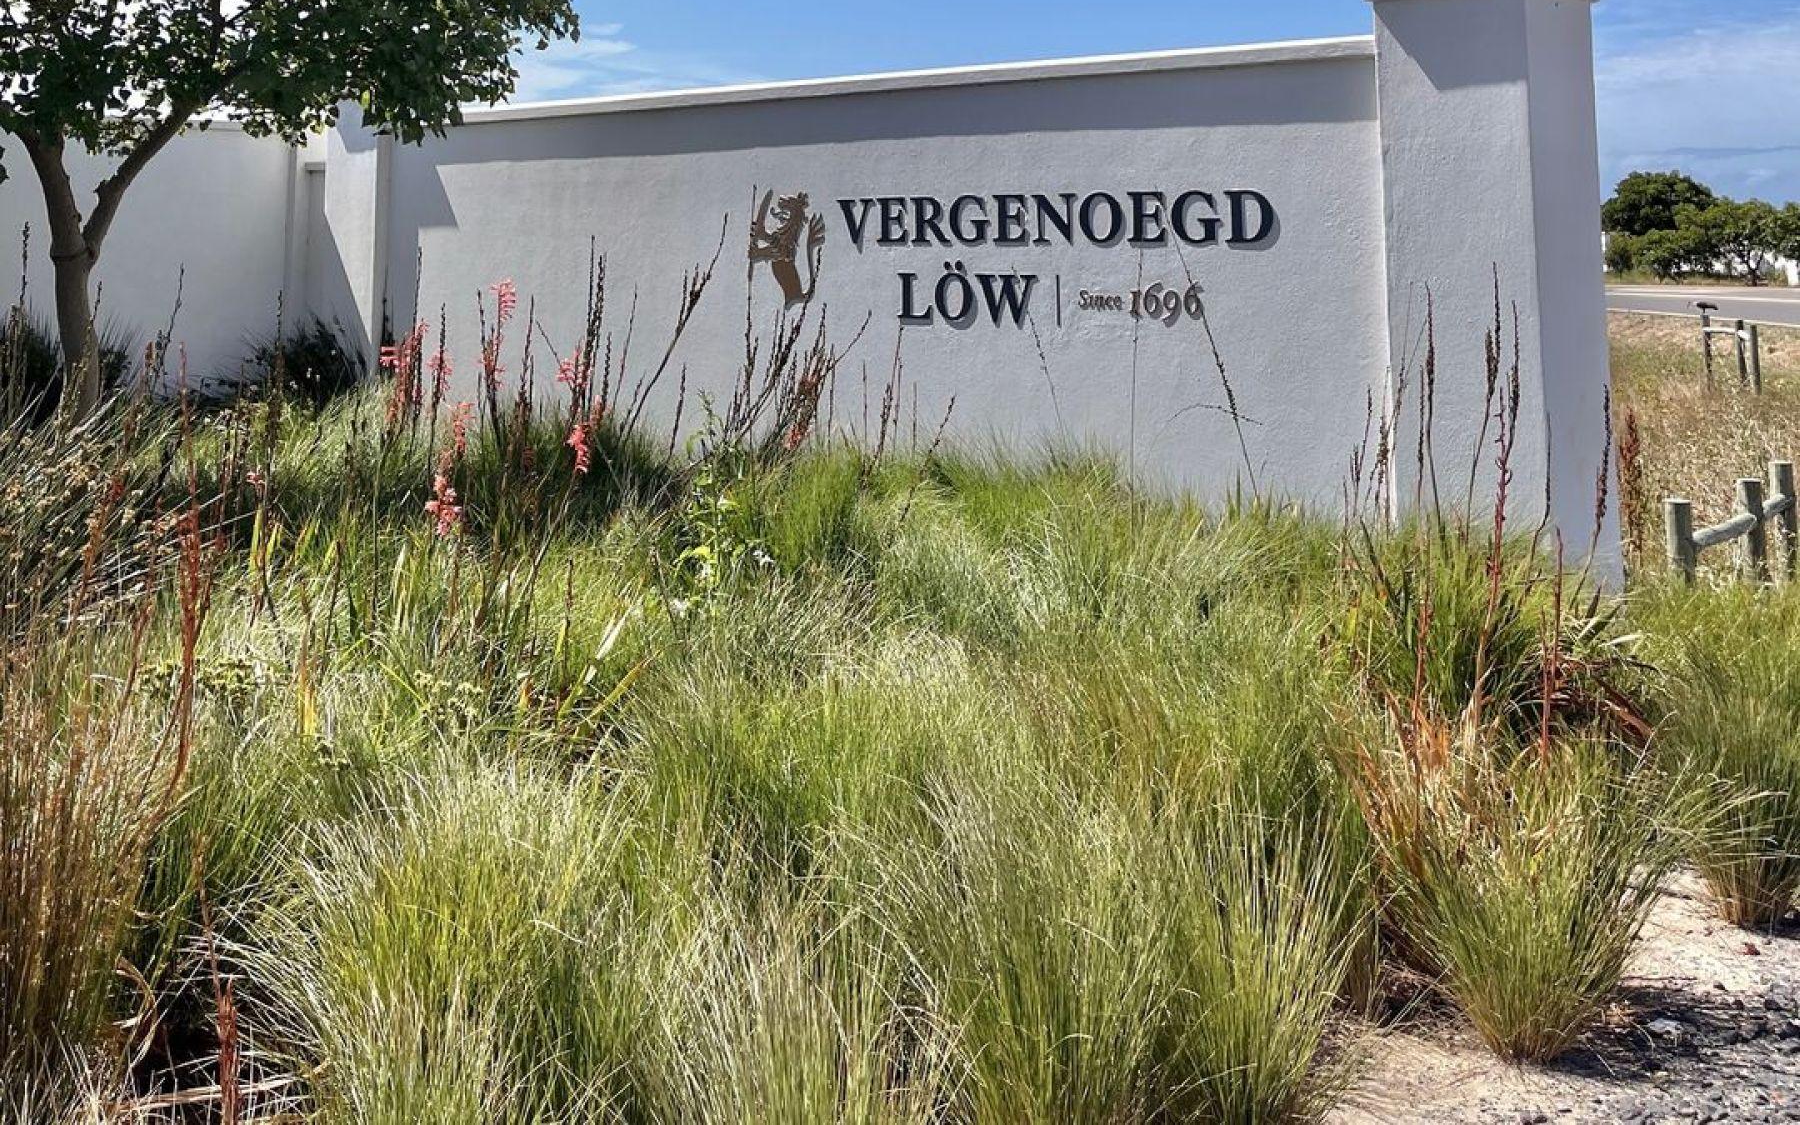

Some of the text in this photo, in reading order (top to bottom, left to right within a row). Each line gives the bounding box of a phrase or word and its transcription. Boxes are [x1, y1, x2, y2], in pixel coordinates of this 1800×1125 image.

[836, 189, 1275, 248] VERGENOEGD
[896, 259, 1038, 325] LÖW
[1079, 282, 1203, 326] Since 1696
